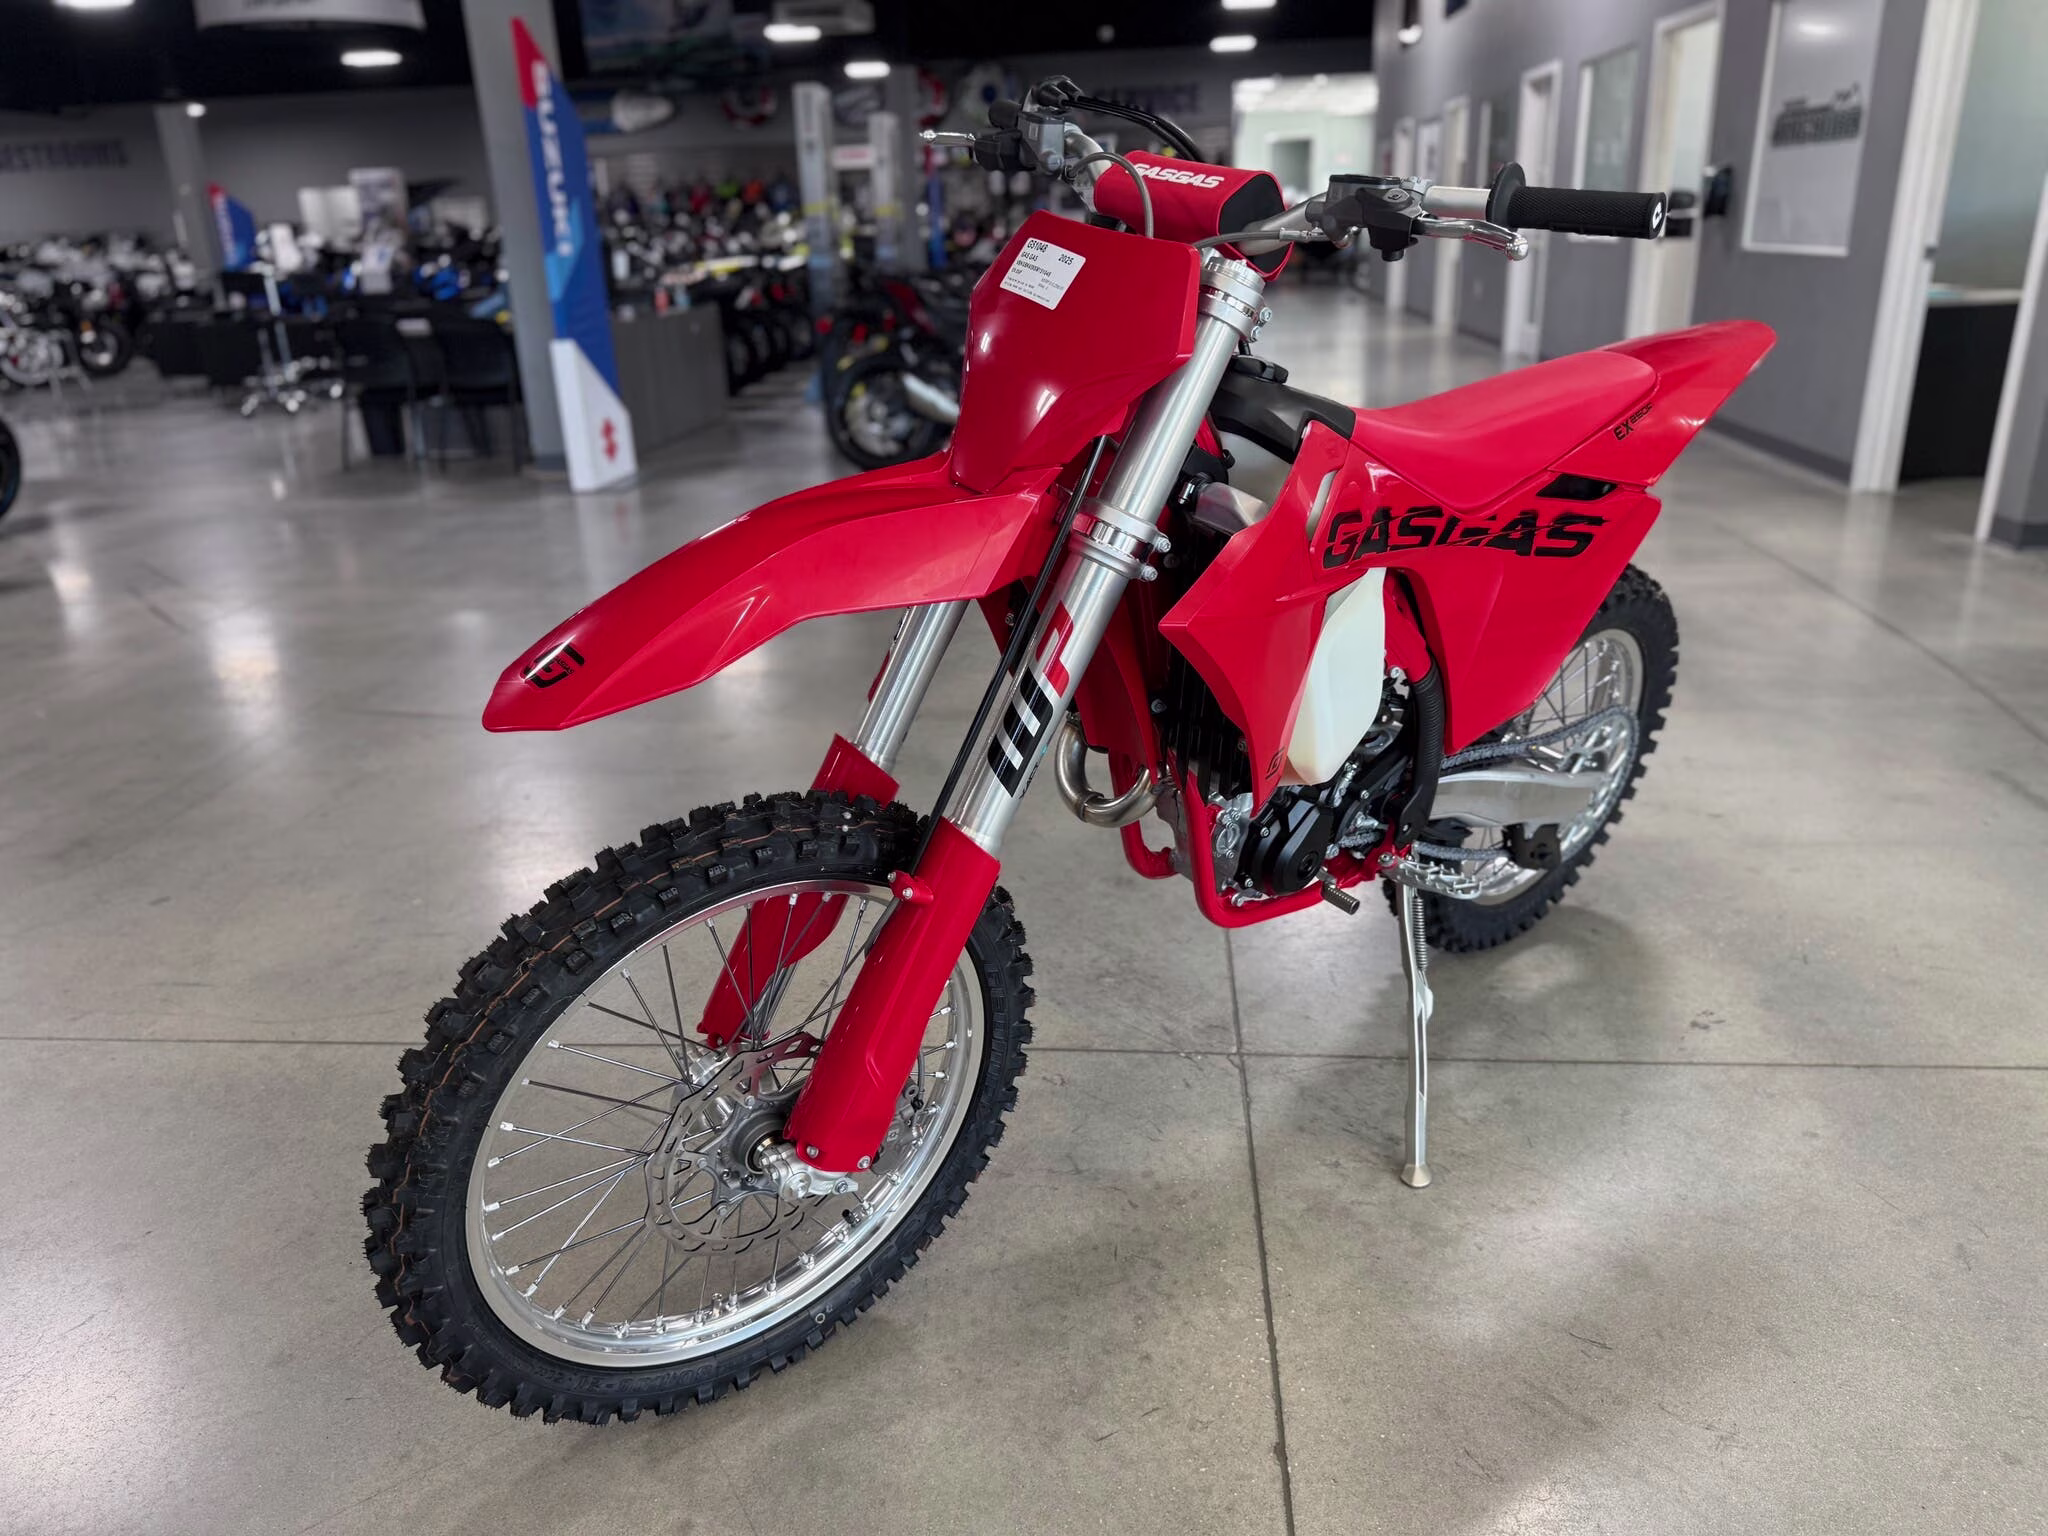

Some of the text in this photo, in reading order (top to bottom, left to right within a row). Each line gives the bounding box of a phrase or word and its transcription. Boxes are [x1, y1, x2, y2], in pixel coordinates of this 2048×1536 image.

[531, 60, 573, 257] SUZUKI
[1126, 163, 1224, 188] GASGAS
[1058, 254, 1074, 266] 2025
[1322, 506, 1609, 569] GASGAS
